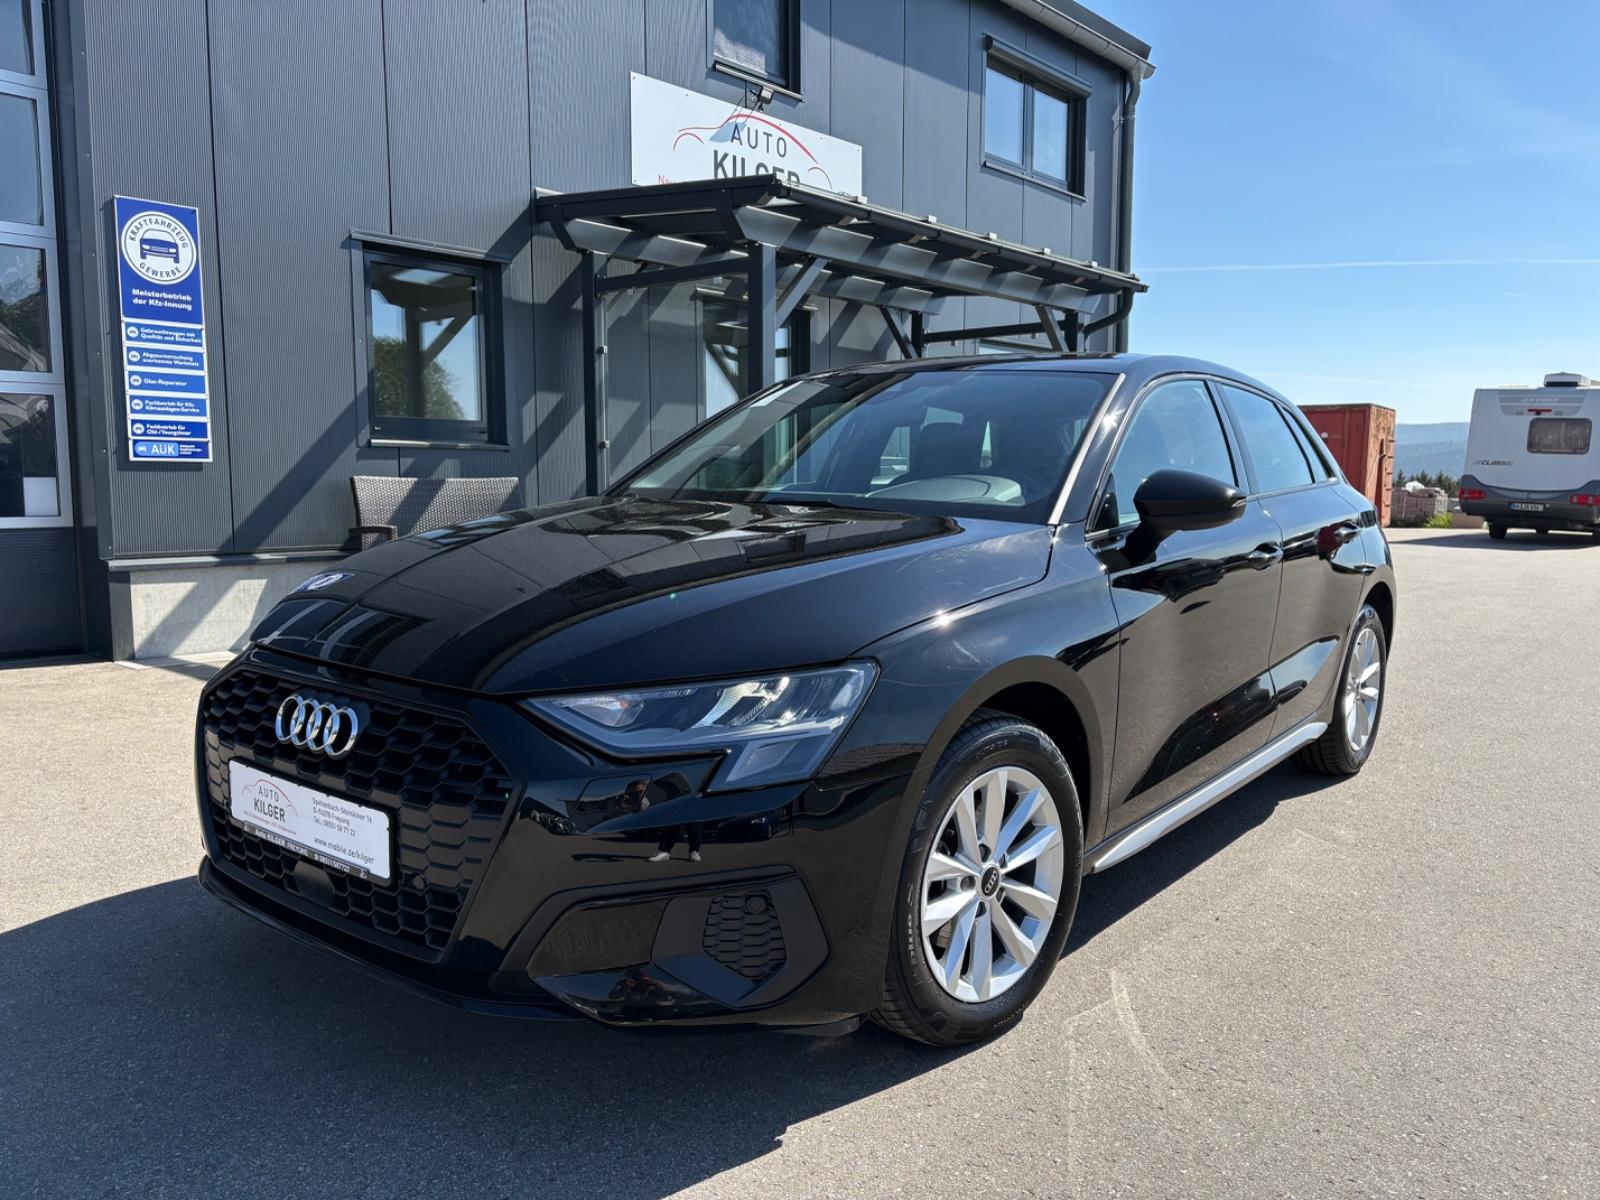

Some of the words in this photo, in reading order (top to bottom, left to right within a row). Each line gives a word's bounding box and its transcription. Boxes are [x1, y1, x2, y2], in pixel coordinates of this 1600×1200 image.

[731, 123, 787, 158] AUTO
[128, 217, 189, 249] KRAFTFAHRZEUG
[139, 262, 182, 278] GEWERBE
[132, 288, 192, 301] Meisterbetrieb
[132, 297, 147, 305] der
[148, 299, 192, 311] Kfz-Innung
[151, 443, 175, 455] AUK
[258, 785, 280, 802] AUTO
[253, 797, 286, 823] KILGER
[314, 837, 375, 864] www.mobile.de/kilger
